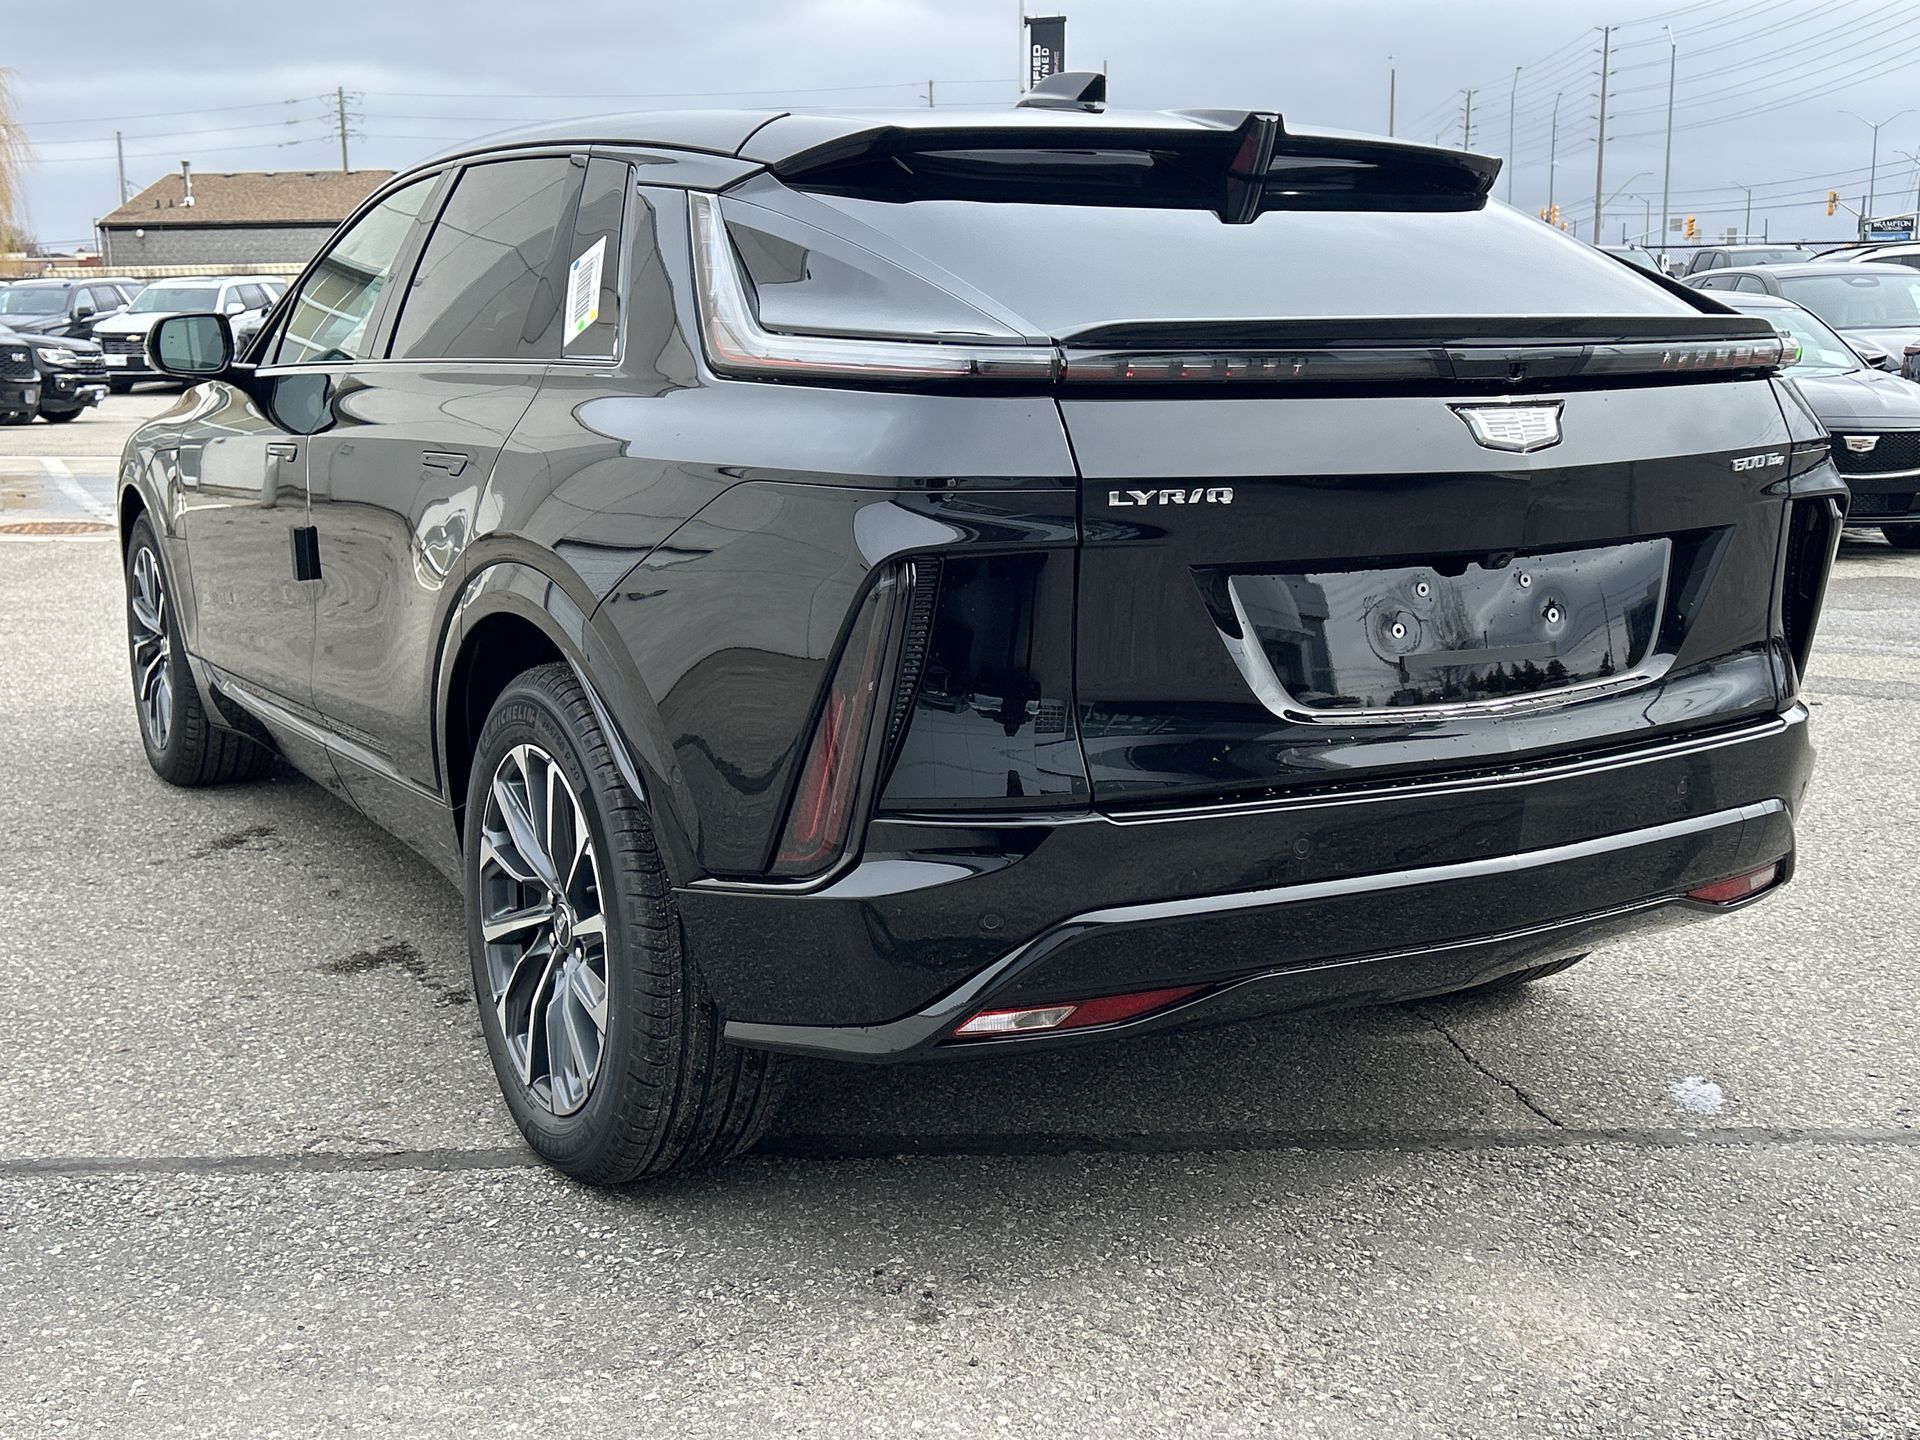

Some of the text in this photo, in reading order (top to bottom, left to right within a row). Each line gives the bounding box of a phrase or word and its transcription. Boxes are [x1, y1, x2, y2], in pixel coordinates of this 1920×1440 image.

[1032, 44, 1041, 87] IFIED
[1732, 455, 1766, 471] 600
[1108, 487, 1233, 506] LYRIQ
[490, 705, 536, 735] MICHELIN
